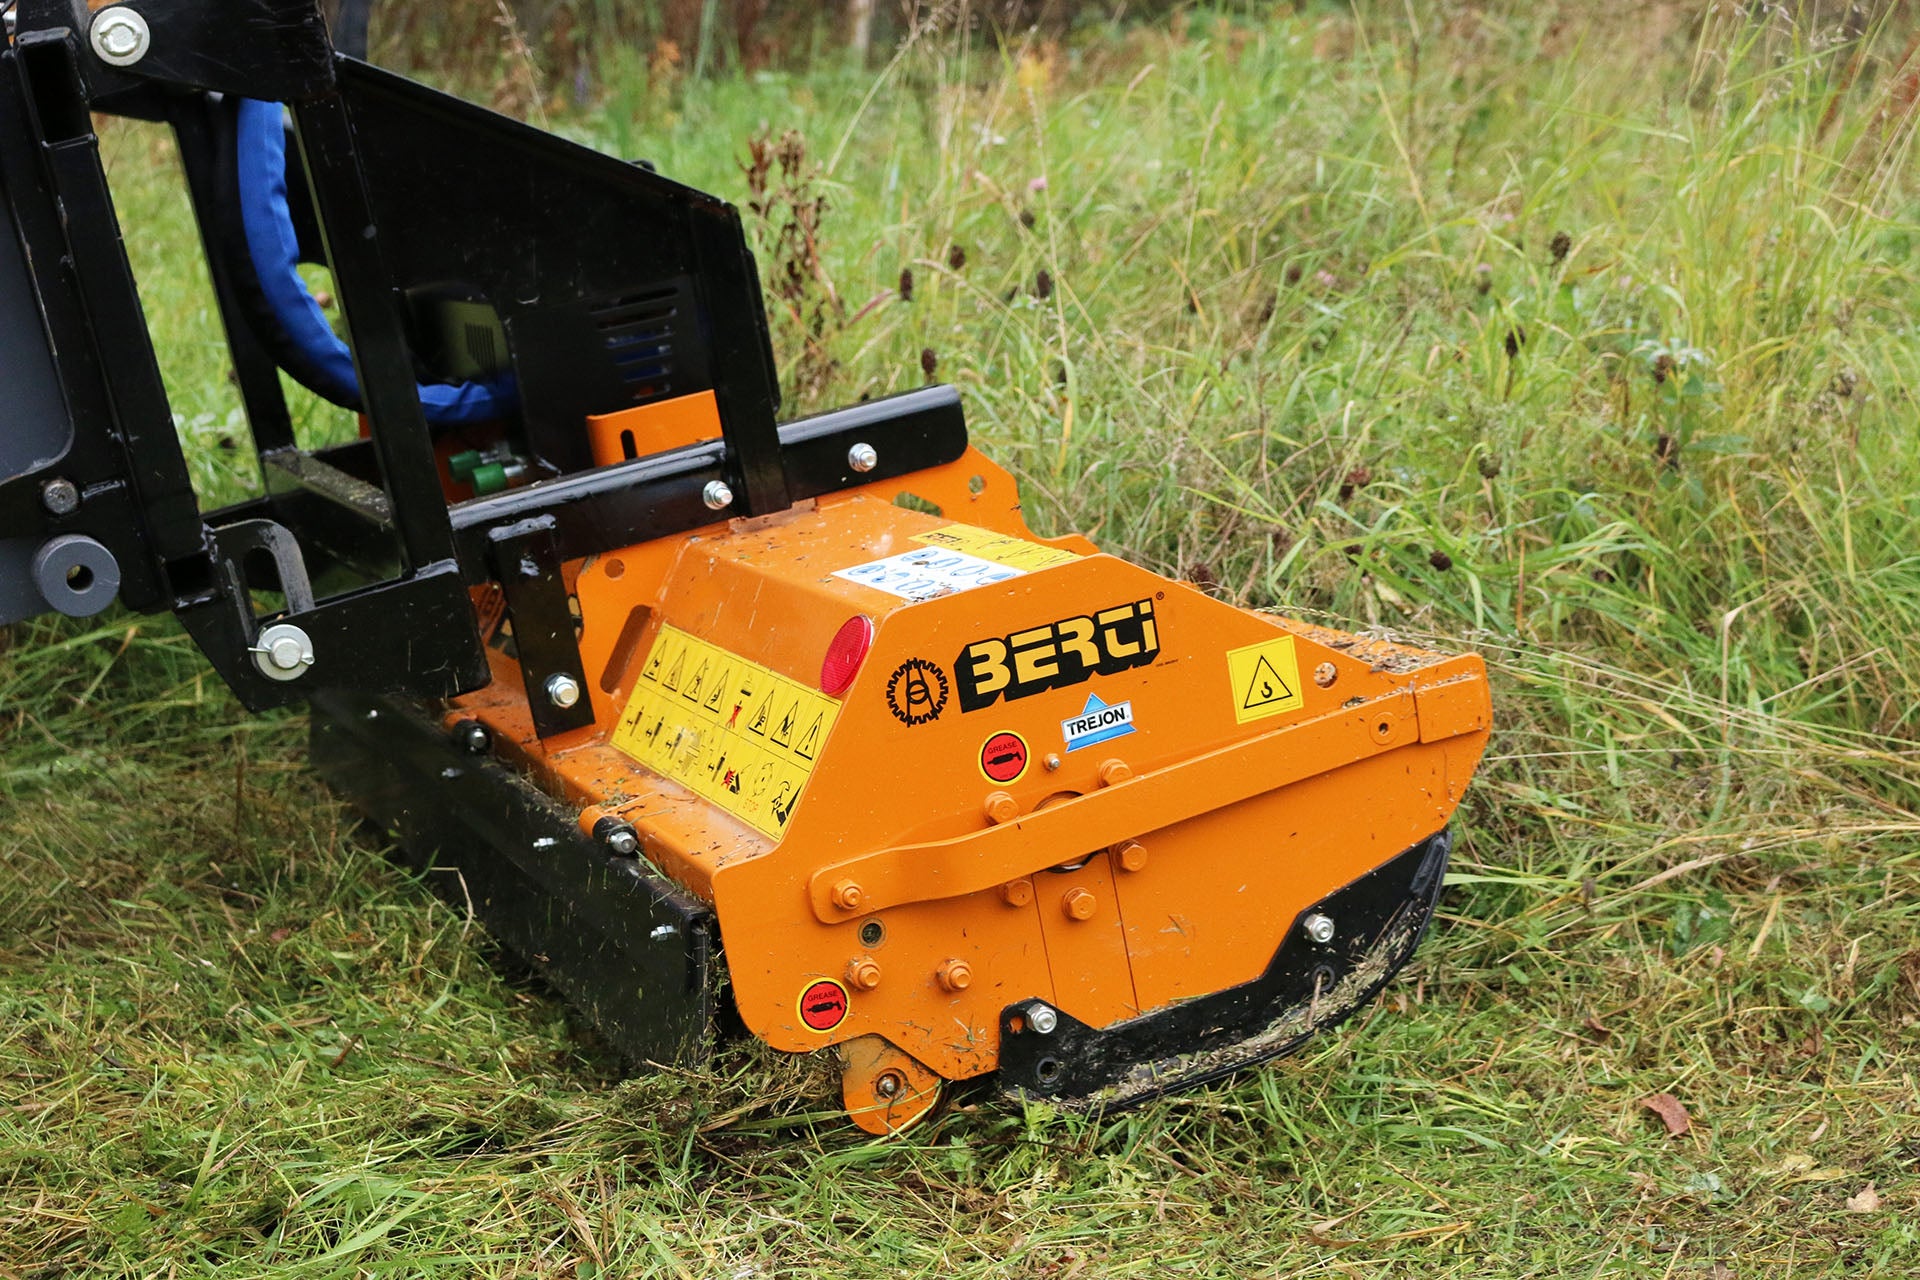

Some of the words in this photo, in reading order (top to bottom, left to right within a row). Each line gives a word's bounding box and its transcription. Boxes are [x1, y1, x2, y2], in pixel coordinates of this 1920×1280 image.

[1066, 706, 1126, 736] TREJON
[987, 741, 1018, 754] GREASE
[807, 989, 839, 1002] GREASE
